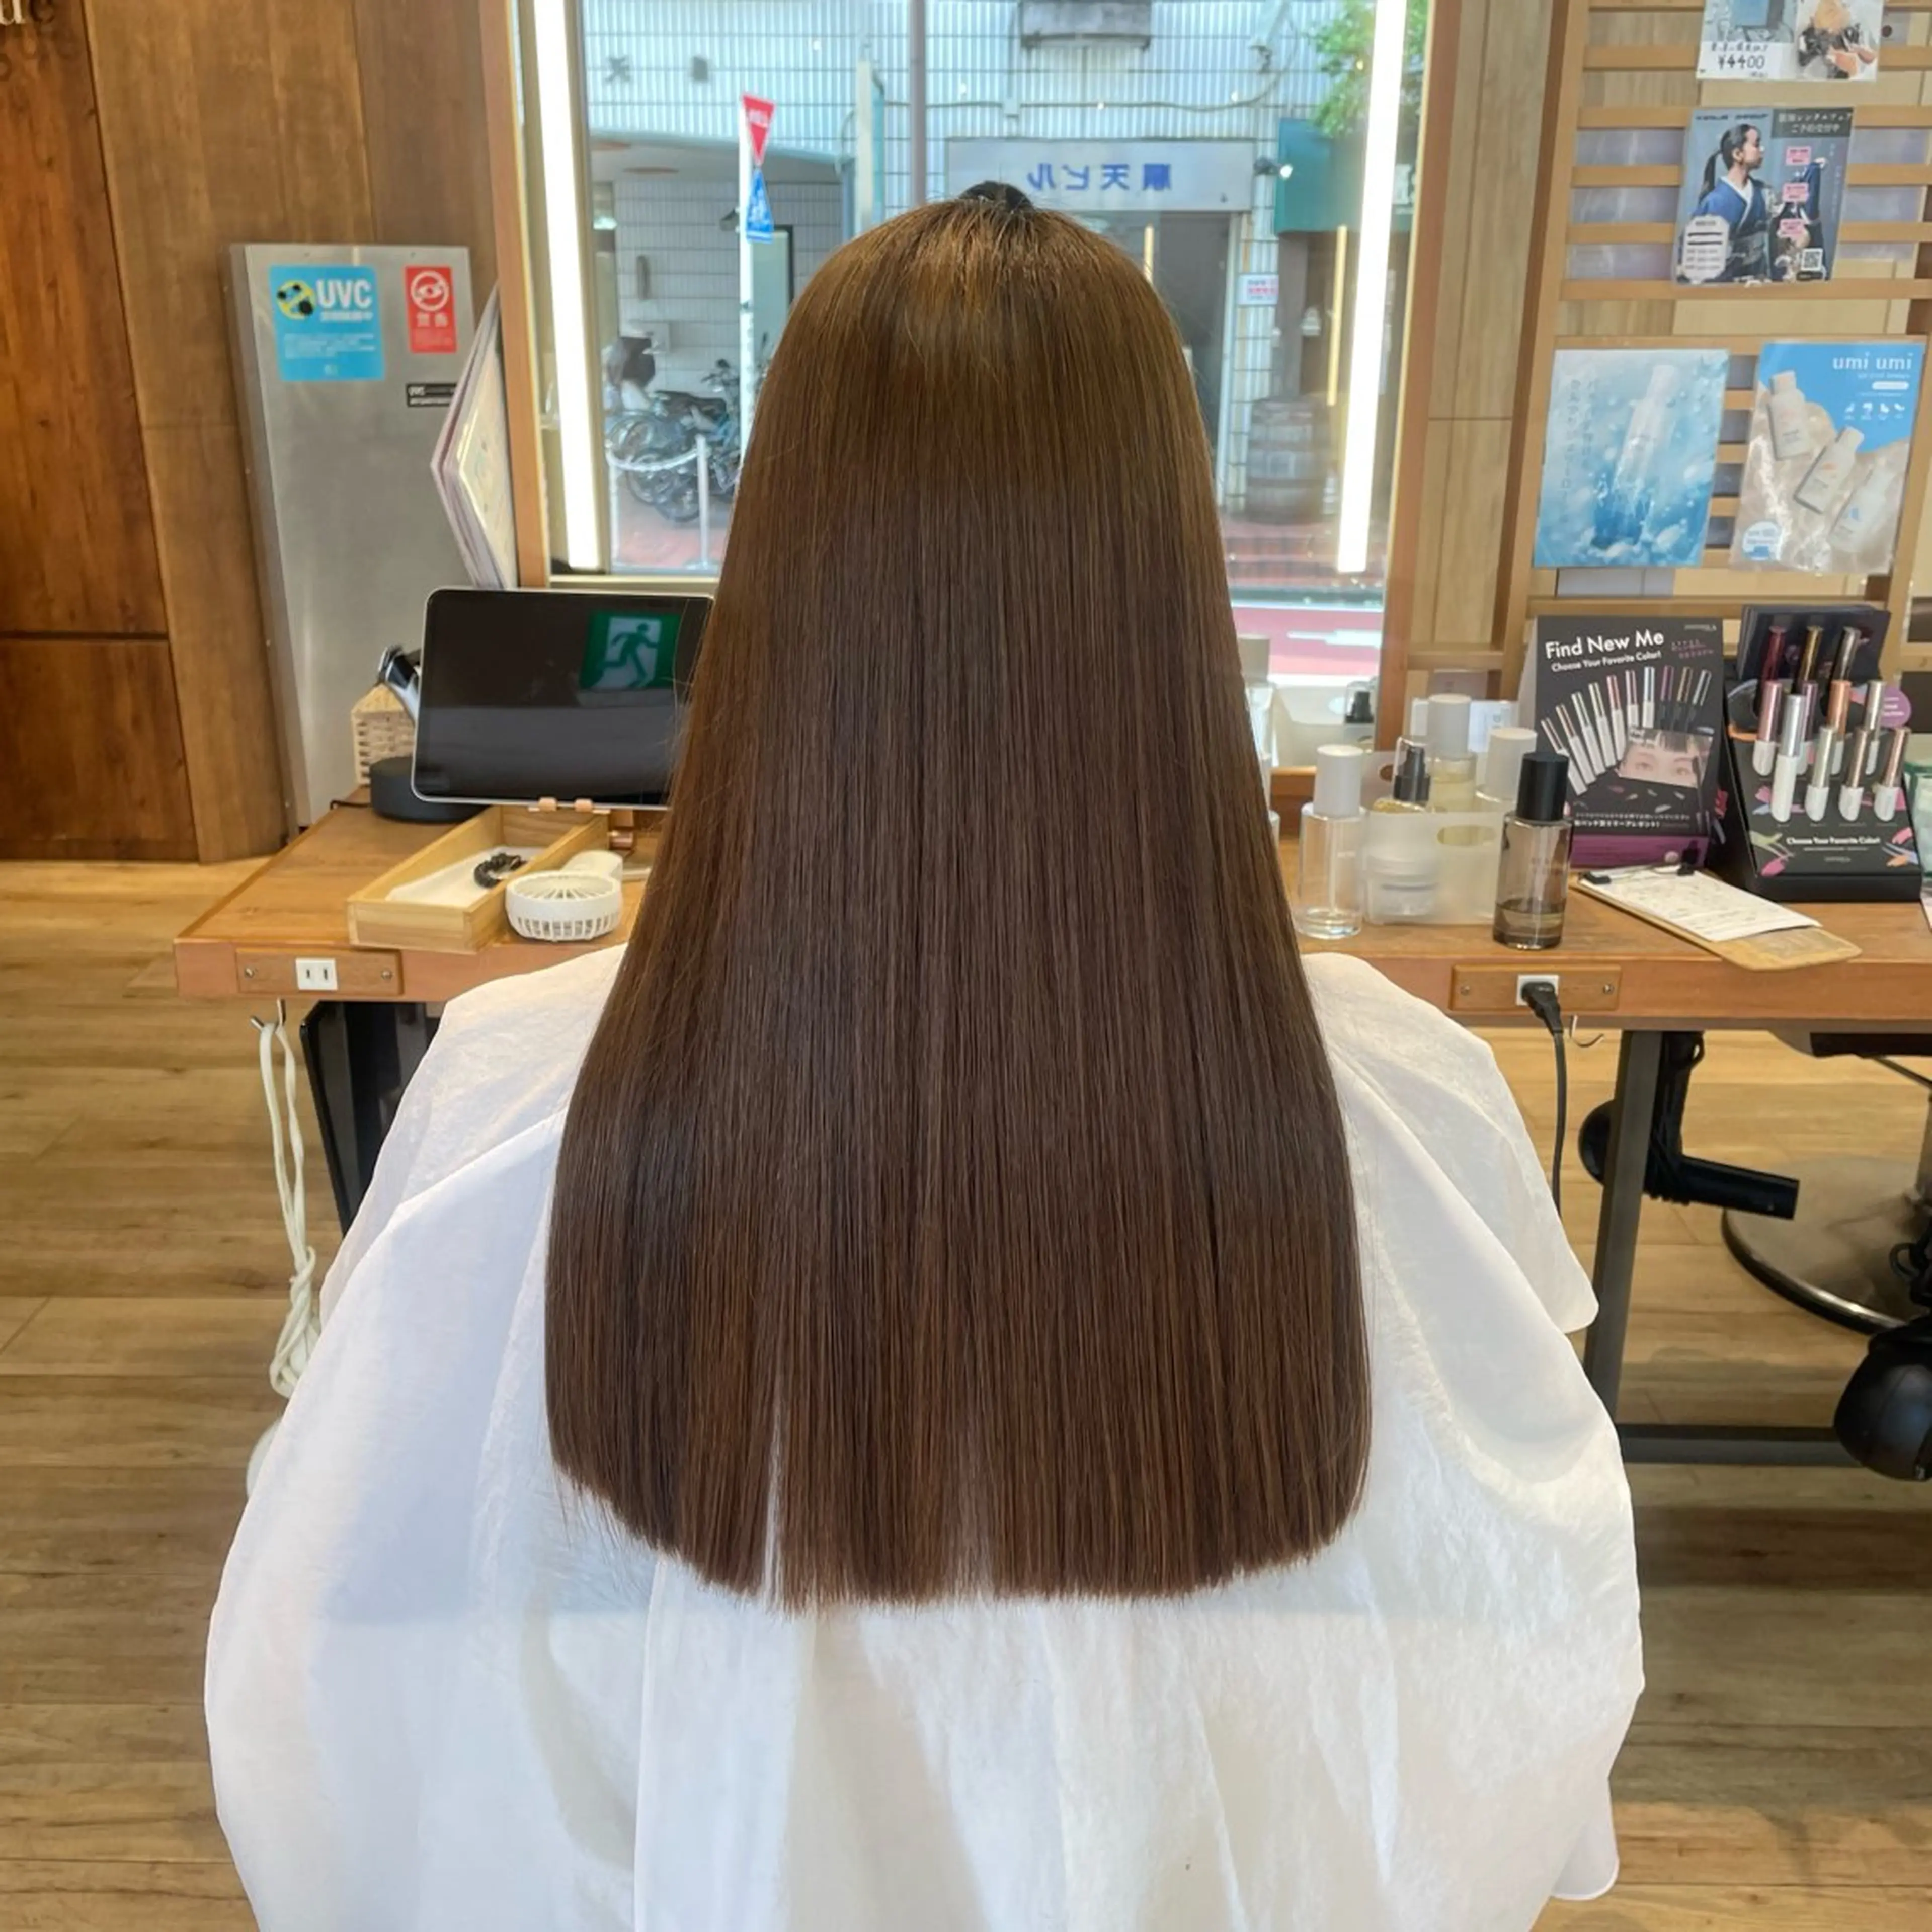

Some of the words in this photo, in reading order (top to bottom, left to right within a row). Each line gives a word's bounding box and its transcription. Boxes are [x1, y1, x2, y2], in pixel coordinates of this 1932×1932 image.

[1718, 54, 1765, 69] ¥4400
[316, 279, 371, 309] UVC
[1833, 351, 1870, 370] umi
[1876, 352, 1913, 370] umi
[1546, 636, 1582, 659] Find
[1586, 635, 1630, 654] New
[1635, 629, 1664, 647] Me
[1551, 661, 1581, 672] Choose
[1582, 659, 1600, 668] Your
[1602, 655, 1635, 666] Favorite
